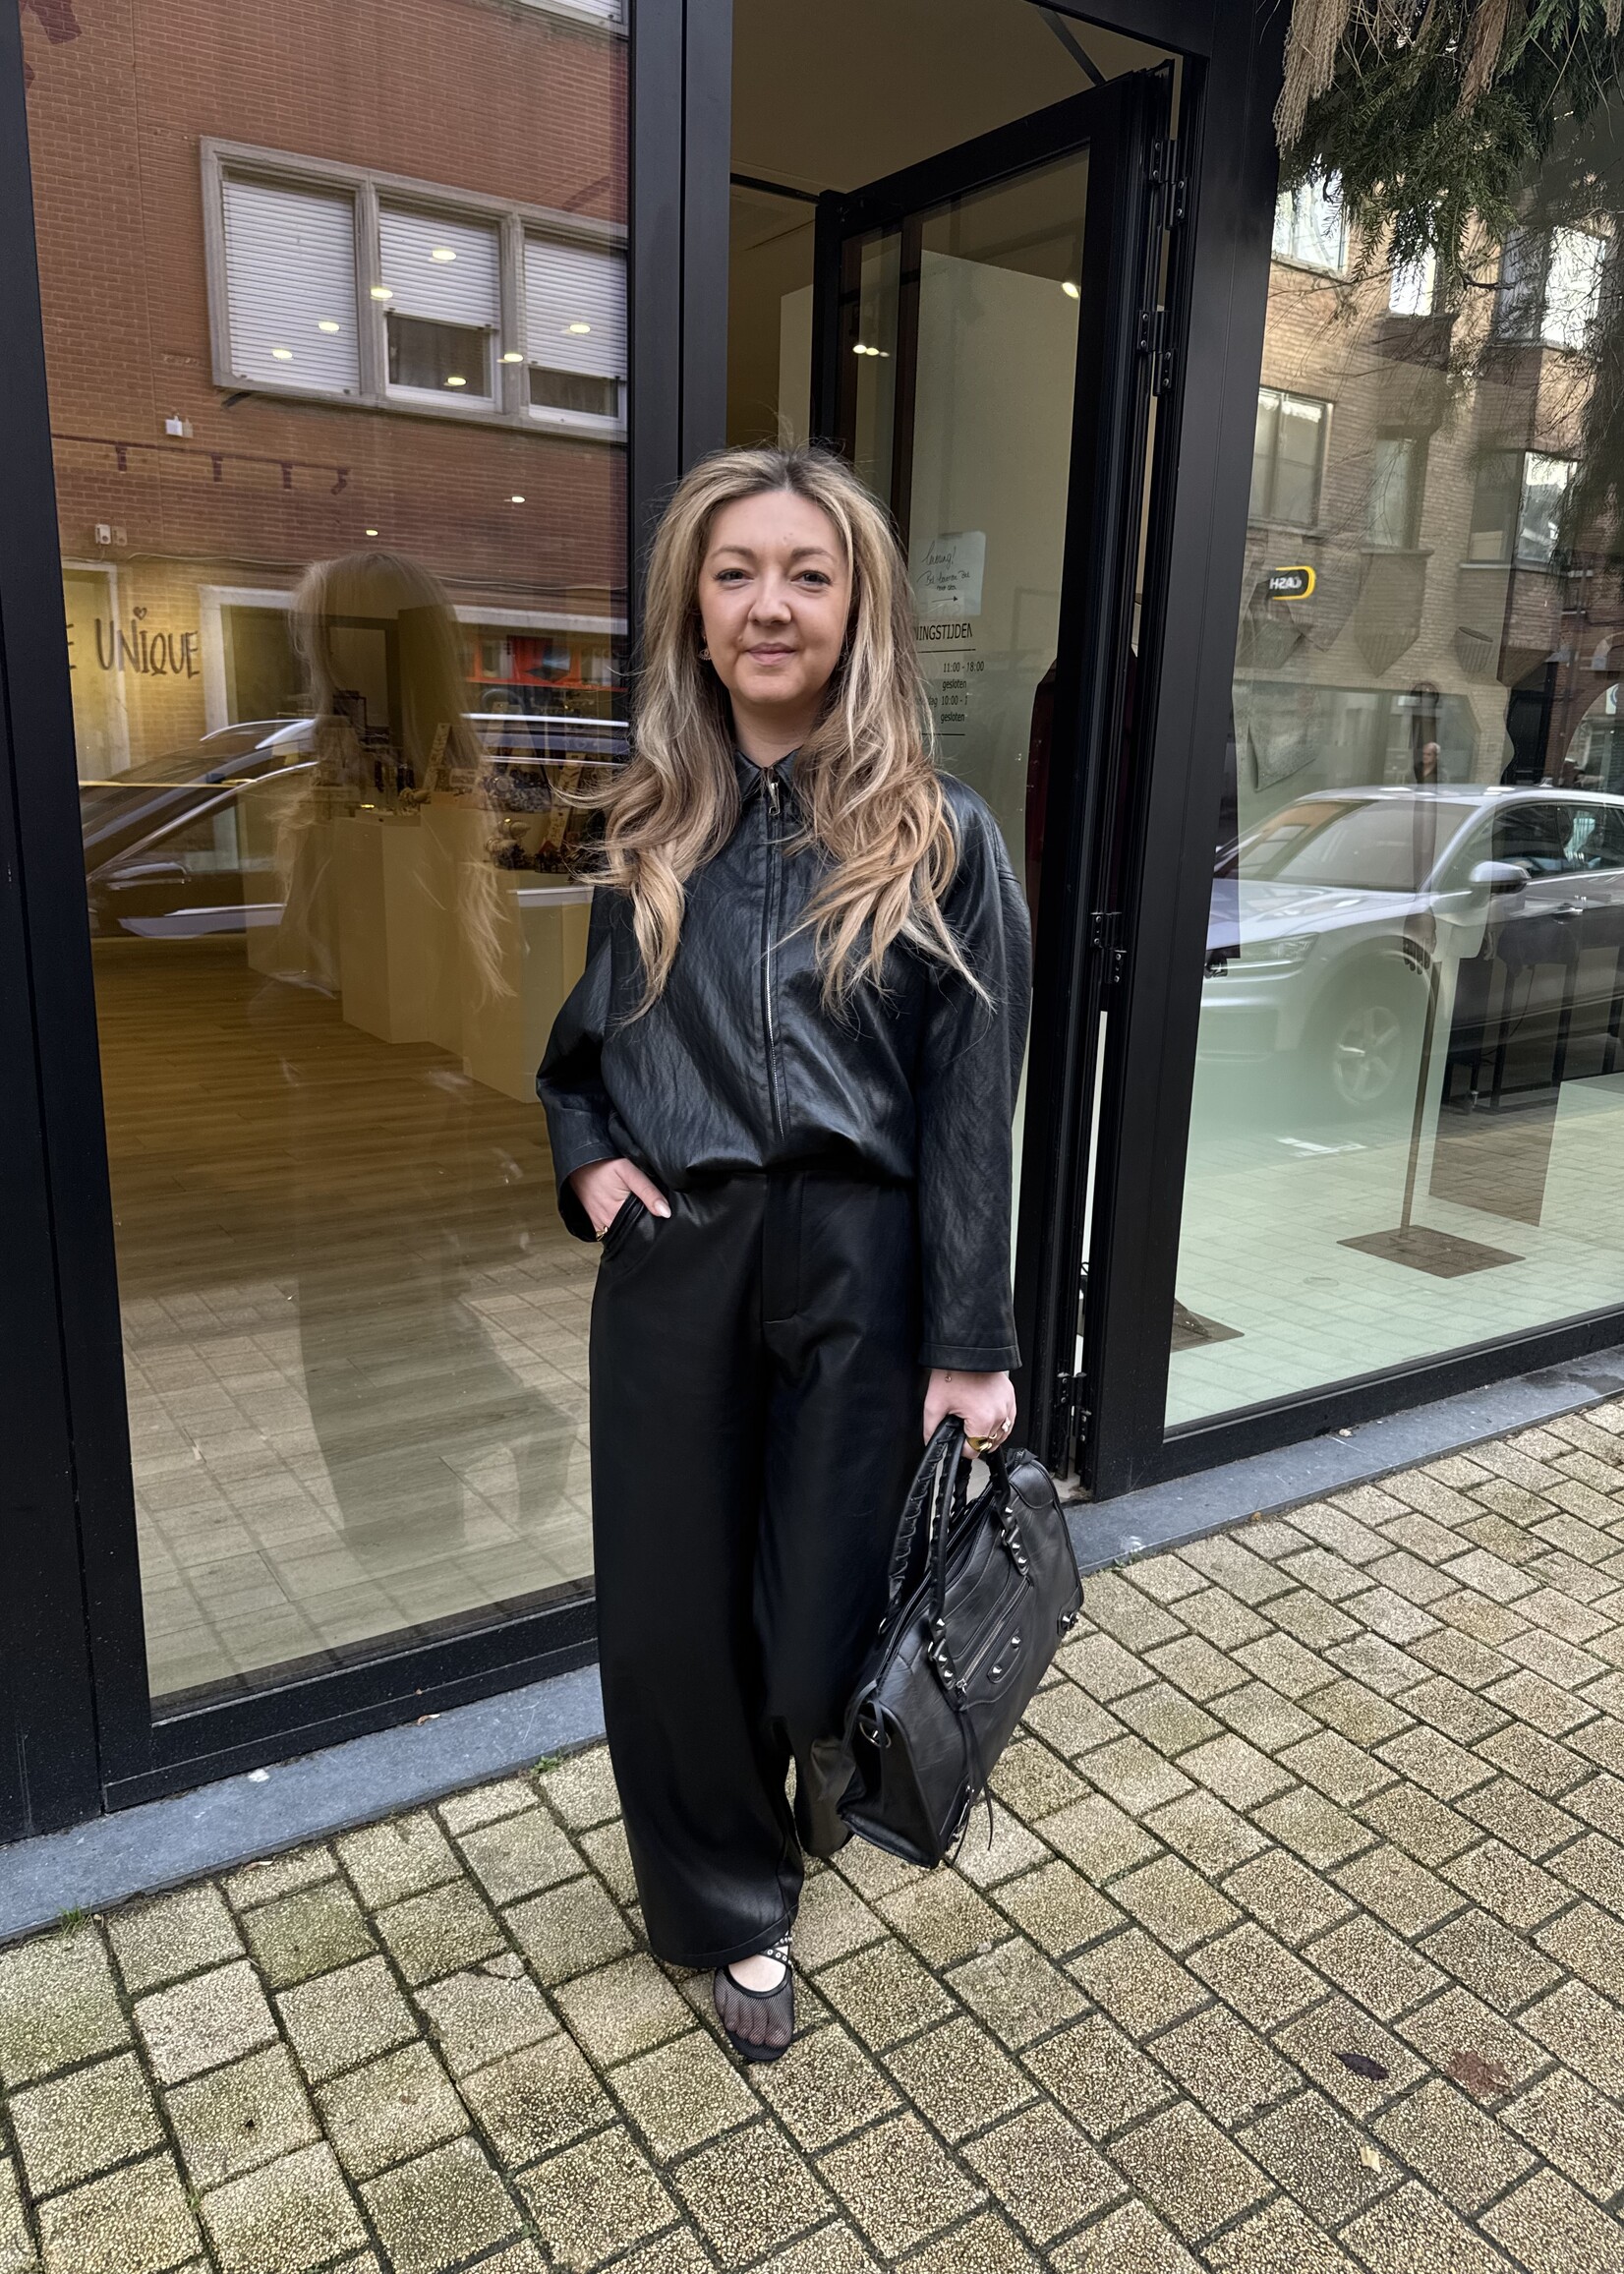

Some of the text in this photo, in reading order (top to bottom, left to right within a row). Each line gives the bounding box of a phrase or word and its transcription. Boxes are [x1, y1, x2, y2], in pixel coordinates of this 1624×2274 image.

[94, 617, 201, 679] UNIQUE
[944, 662, 960, 672] 11:00
[967, 661, 985, 672] 18:00
[942, 678, 967, 691] gesloten
[942, 694, 958, 706] 10:00
[940, 711, 965, 724] gesloten
